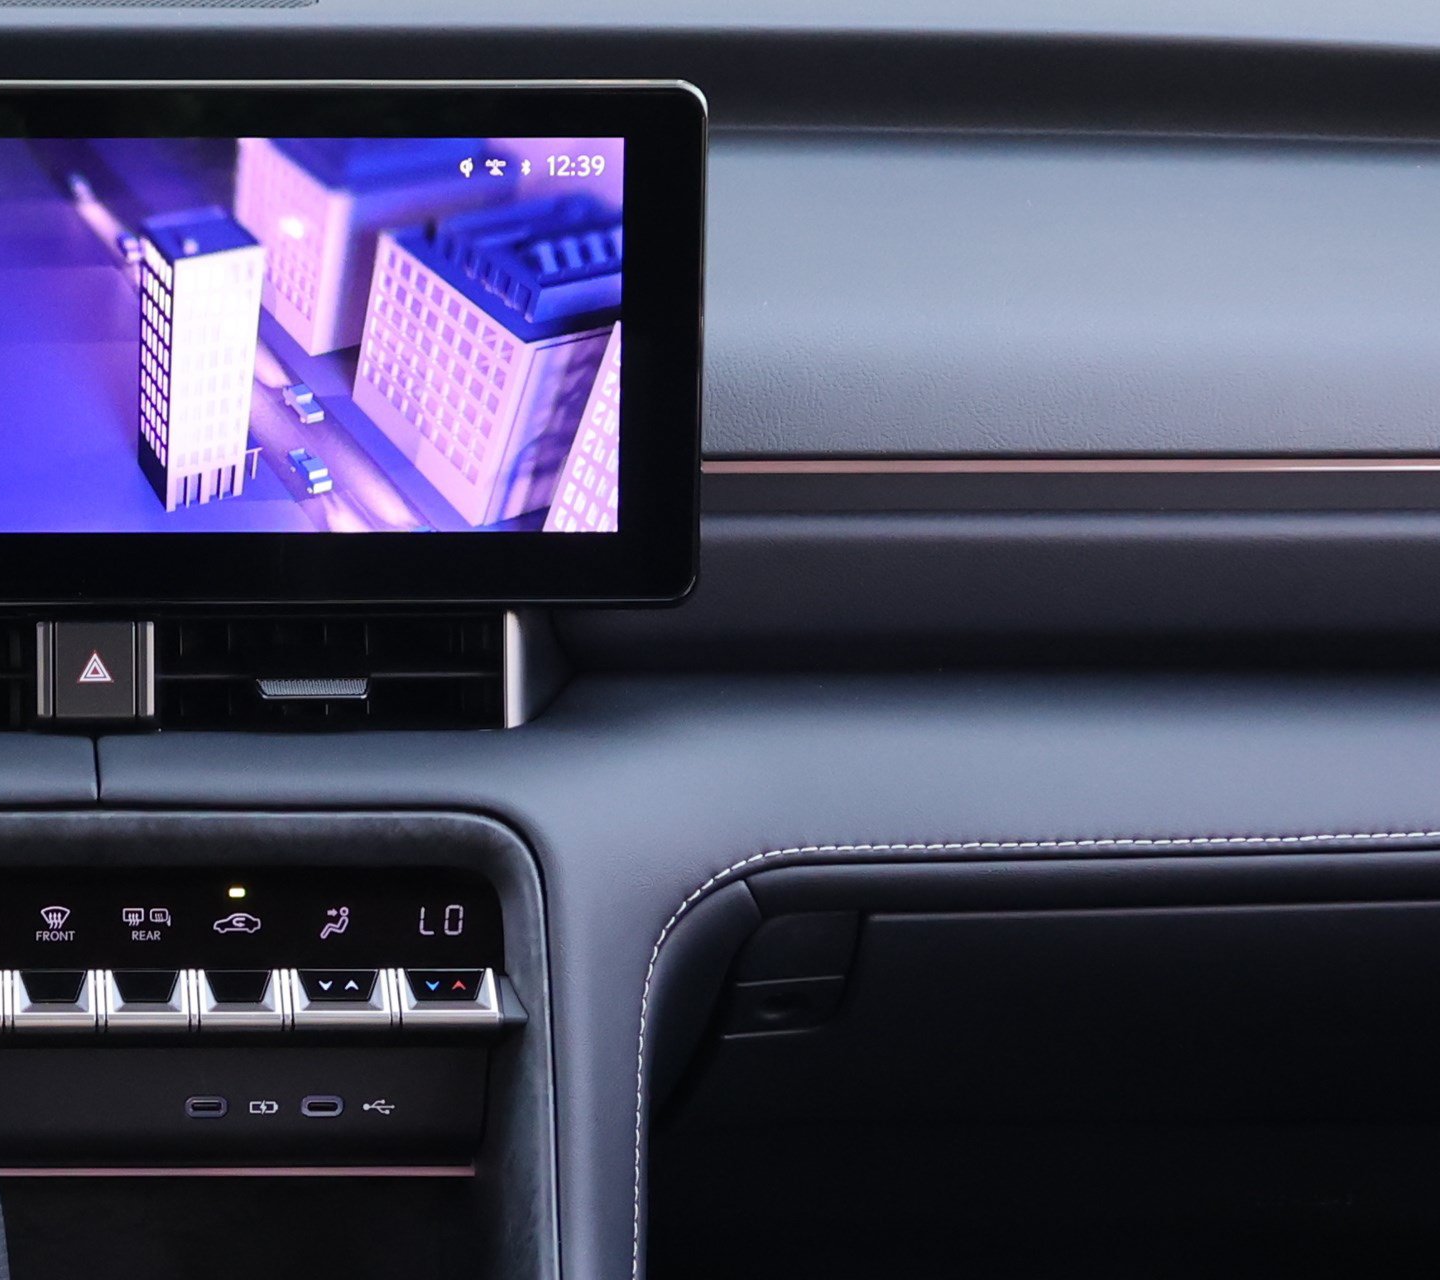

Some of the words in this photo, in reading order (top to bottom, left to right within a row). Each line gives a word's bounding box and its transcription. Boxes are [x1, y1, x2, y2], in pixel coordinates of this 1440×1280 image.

[546, 155, 606, 177] 12:39
[419, 905, 464, 936] LO
[36, 930, 75, 942] FRONT
[131, 930, 161, 941] REAR
